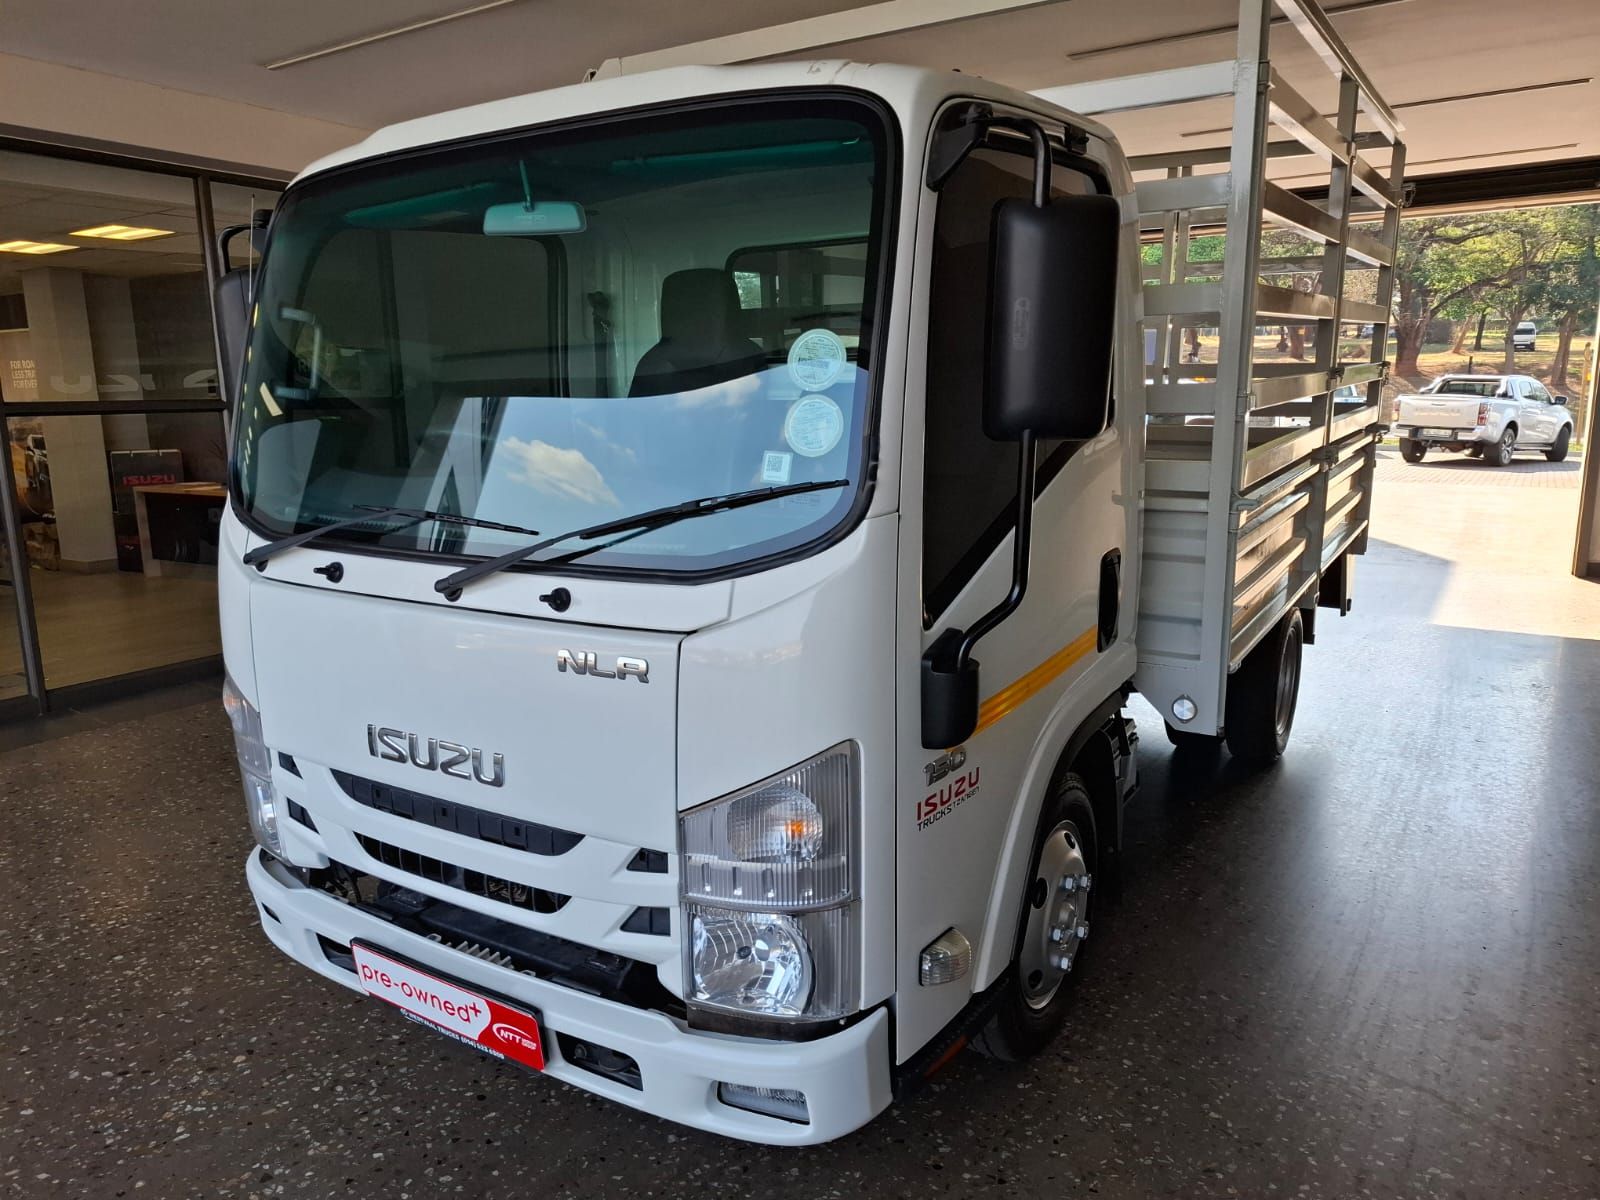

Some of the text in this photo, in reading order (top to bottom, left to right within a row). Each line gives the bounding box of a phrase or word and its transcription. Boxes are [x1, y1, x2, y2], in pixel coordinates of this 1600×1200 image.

[10, 360, 21, 370] FOR
[122, 474, 177, 486] ISUZU
[557, 648, 649, 684] NLR
[367, 723, 506, 788] ISUZU
[923, 745, 967, 787] 150
[916, 766, 981, 821] ISUZU
[916, 804, 952, 832] TRUCKS
[500, 1029, 522, 1044] NTT
